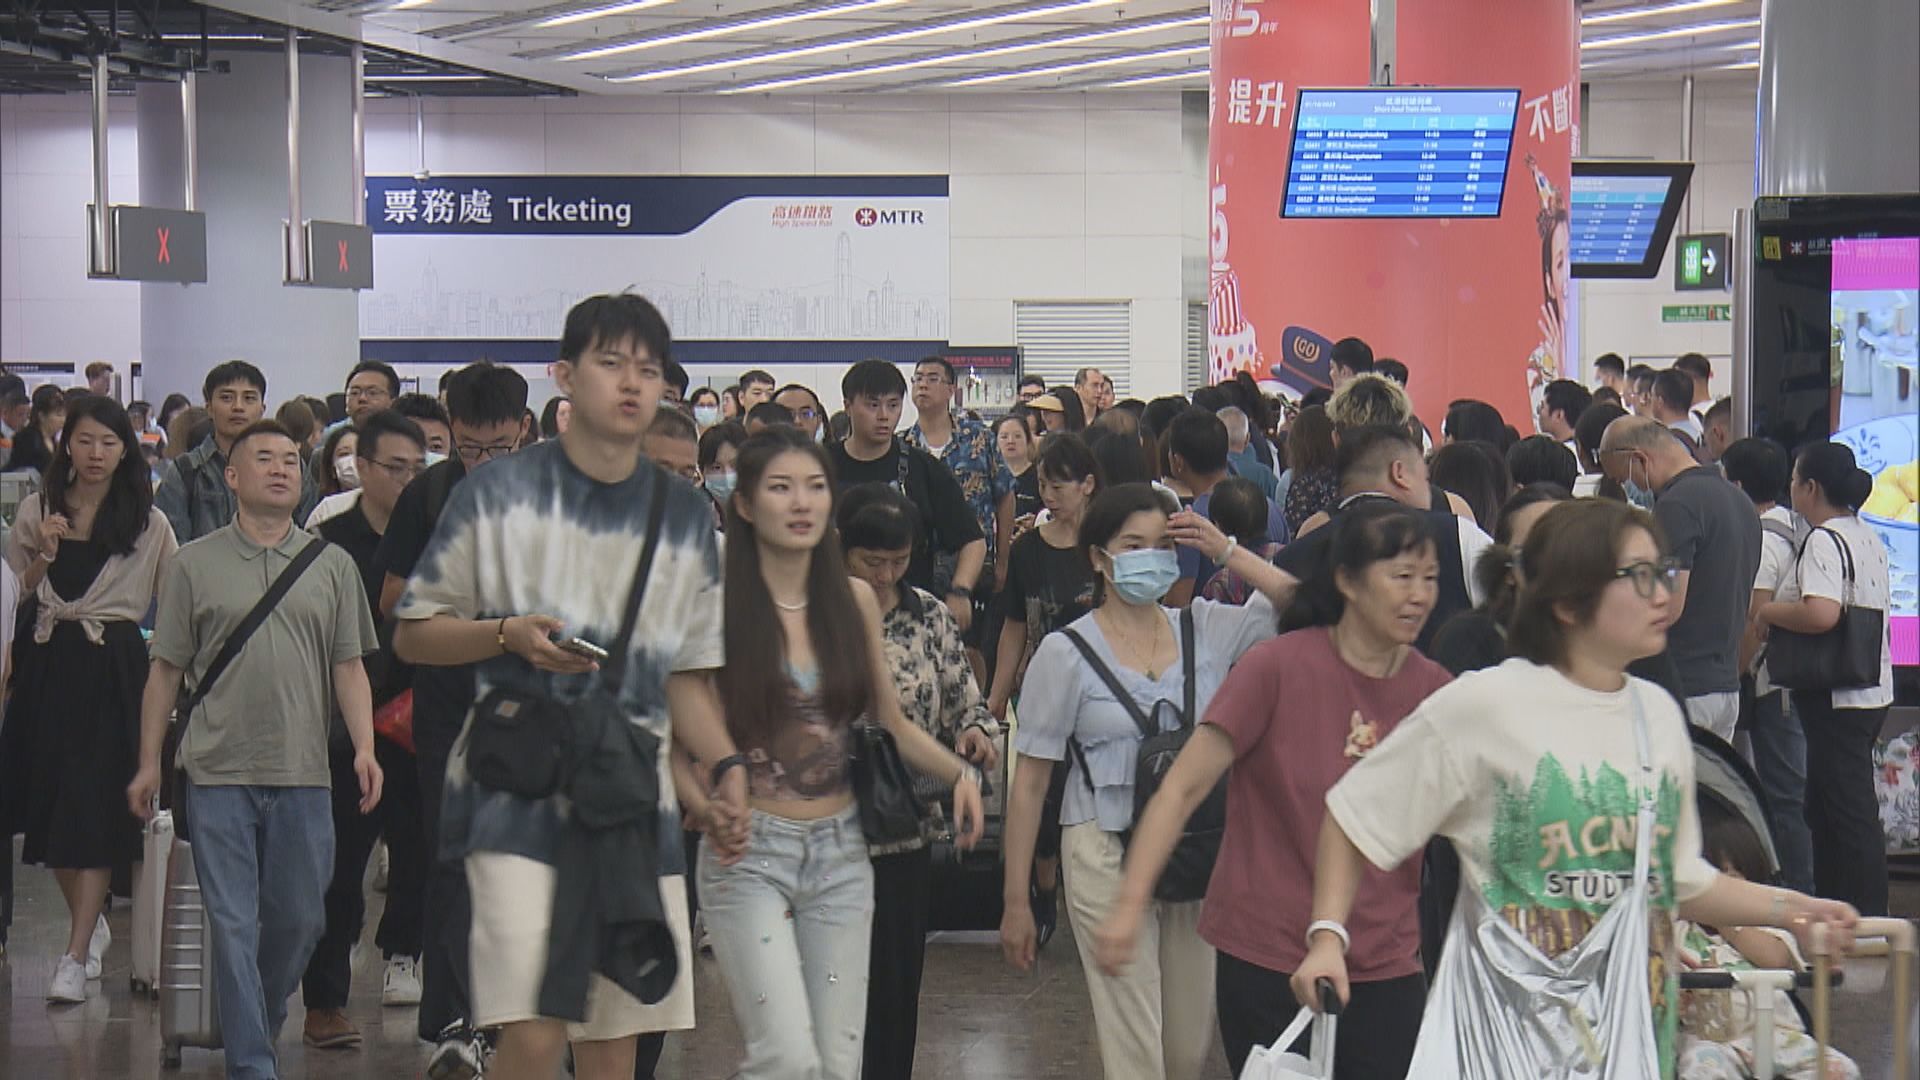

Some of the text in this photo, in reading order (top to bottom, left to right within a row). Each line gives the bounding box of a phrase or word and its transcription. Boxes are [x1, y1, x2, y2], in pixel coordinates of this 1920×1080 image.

[383, 188, 633, 228] 票務處 Ticketing
[772, 204, 833, 219] 高速鐵路
[772, 219, 792, 229] High
[793, 219, 818, 229] Speed
[880, 209, 924, 225] MTR
[1298, 337, 1316, 358] GO
